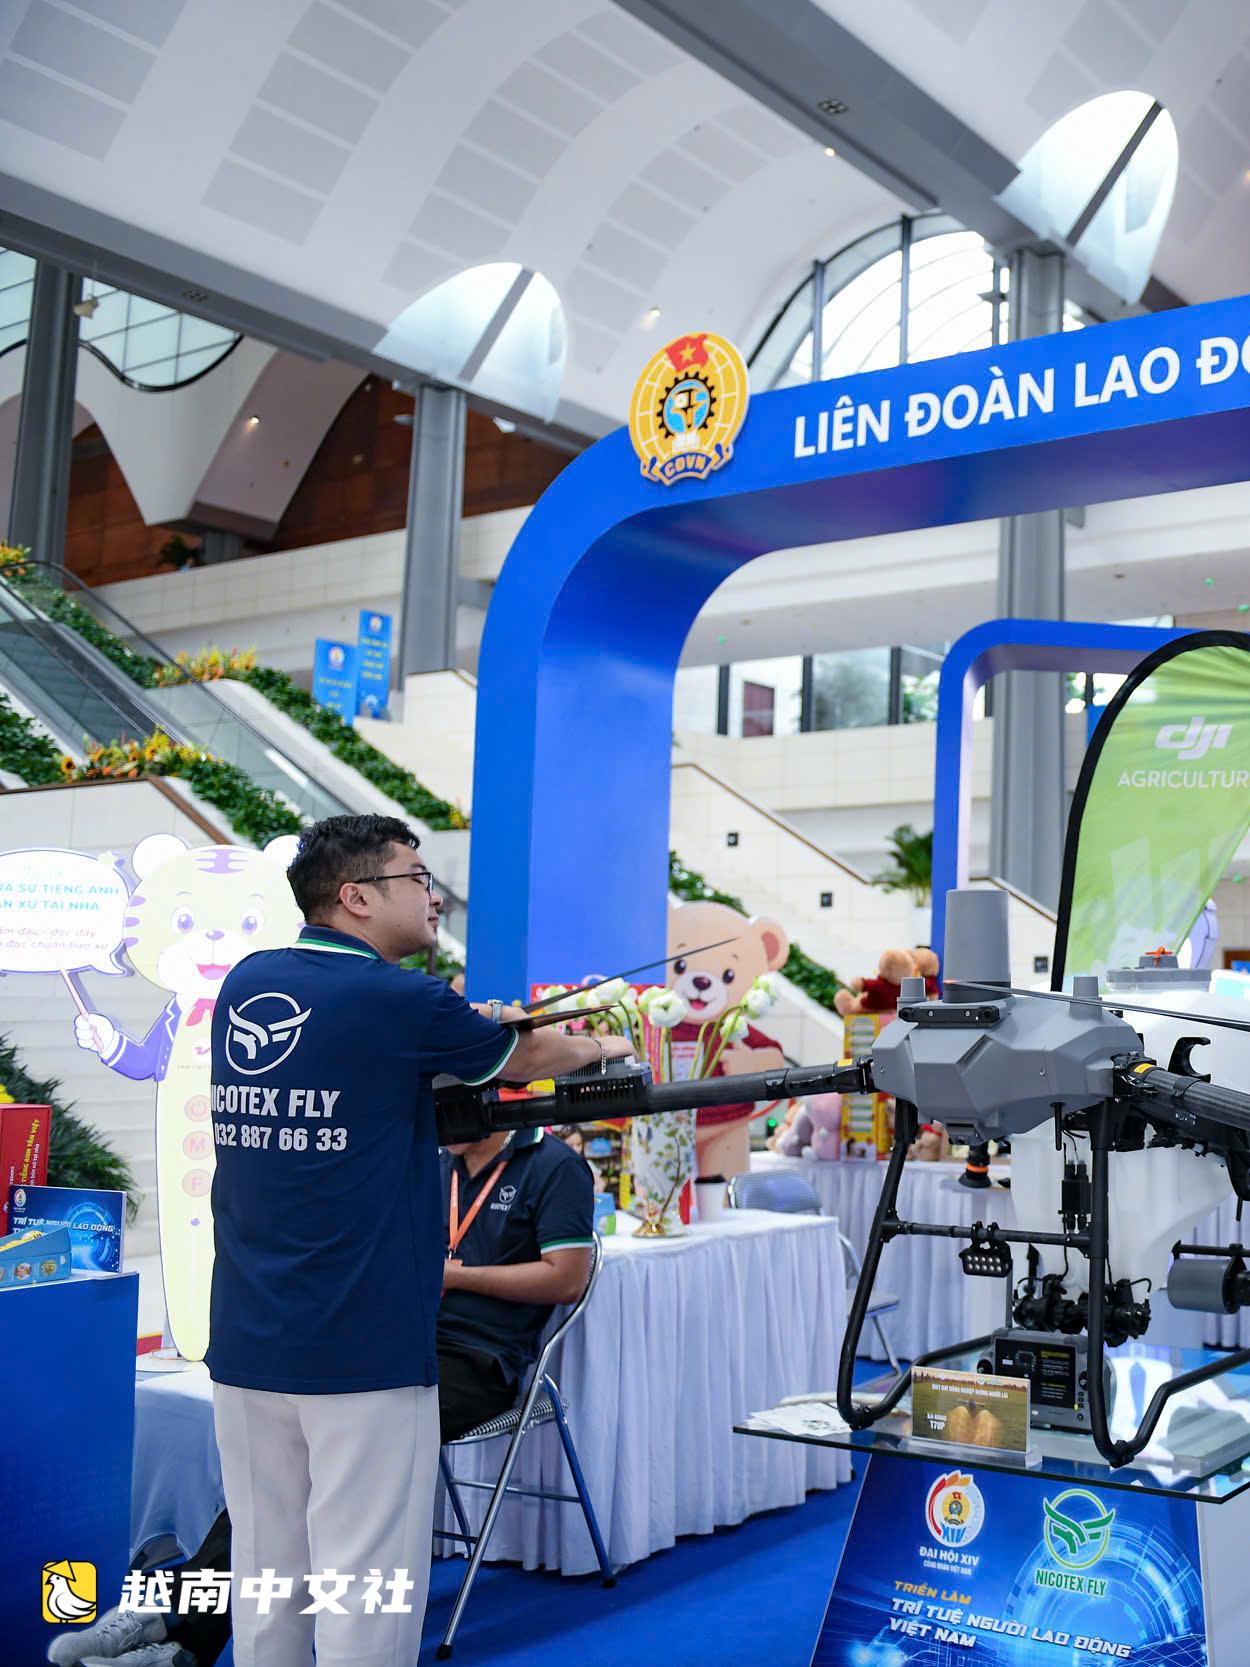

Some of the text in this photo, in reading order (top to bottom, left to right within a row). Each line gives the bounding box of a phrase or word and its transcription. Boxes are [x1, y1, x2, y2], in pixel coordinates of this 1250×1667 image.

[794, 396, 891, 459] LIÊN
[904, 366, 1055, 440] ĐOÀN
[1073, 346, 1181, 409] LAO
[288, 1089, 341, 1118] FLY
[240, 1124, 272, 1149] 887
[278, 1127, 308, 1152] 66
[316, 1127, 348, 1152] 33
[13, 1216, 27, 1226] TRÍ
[73, 1221, 89, 1231] LAO
[919, 1545, 980, 1567] ĐẠI HỘI XIV
[895, 1580, 938, 1598] TRIỂN
[1035, 1569, 1107, 1597] NICOTEX FLY
[889, 1617, 978, 1649] VIỆT NAM
[891, 1596, 1132, 1659] TRÍ TUỆ NGƯỜI LAO ĐỘNG
